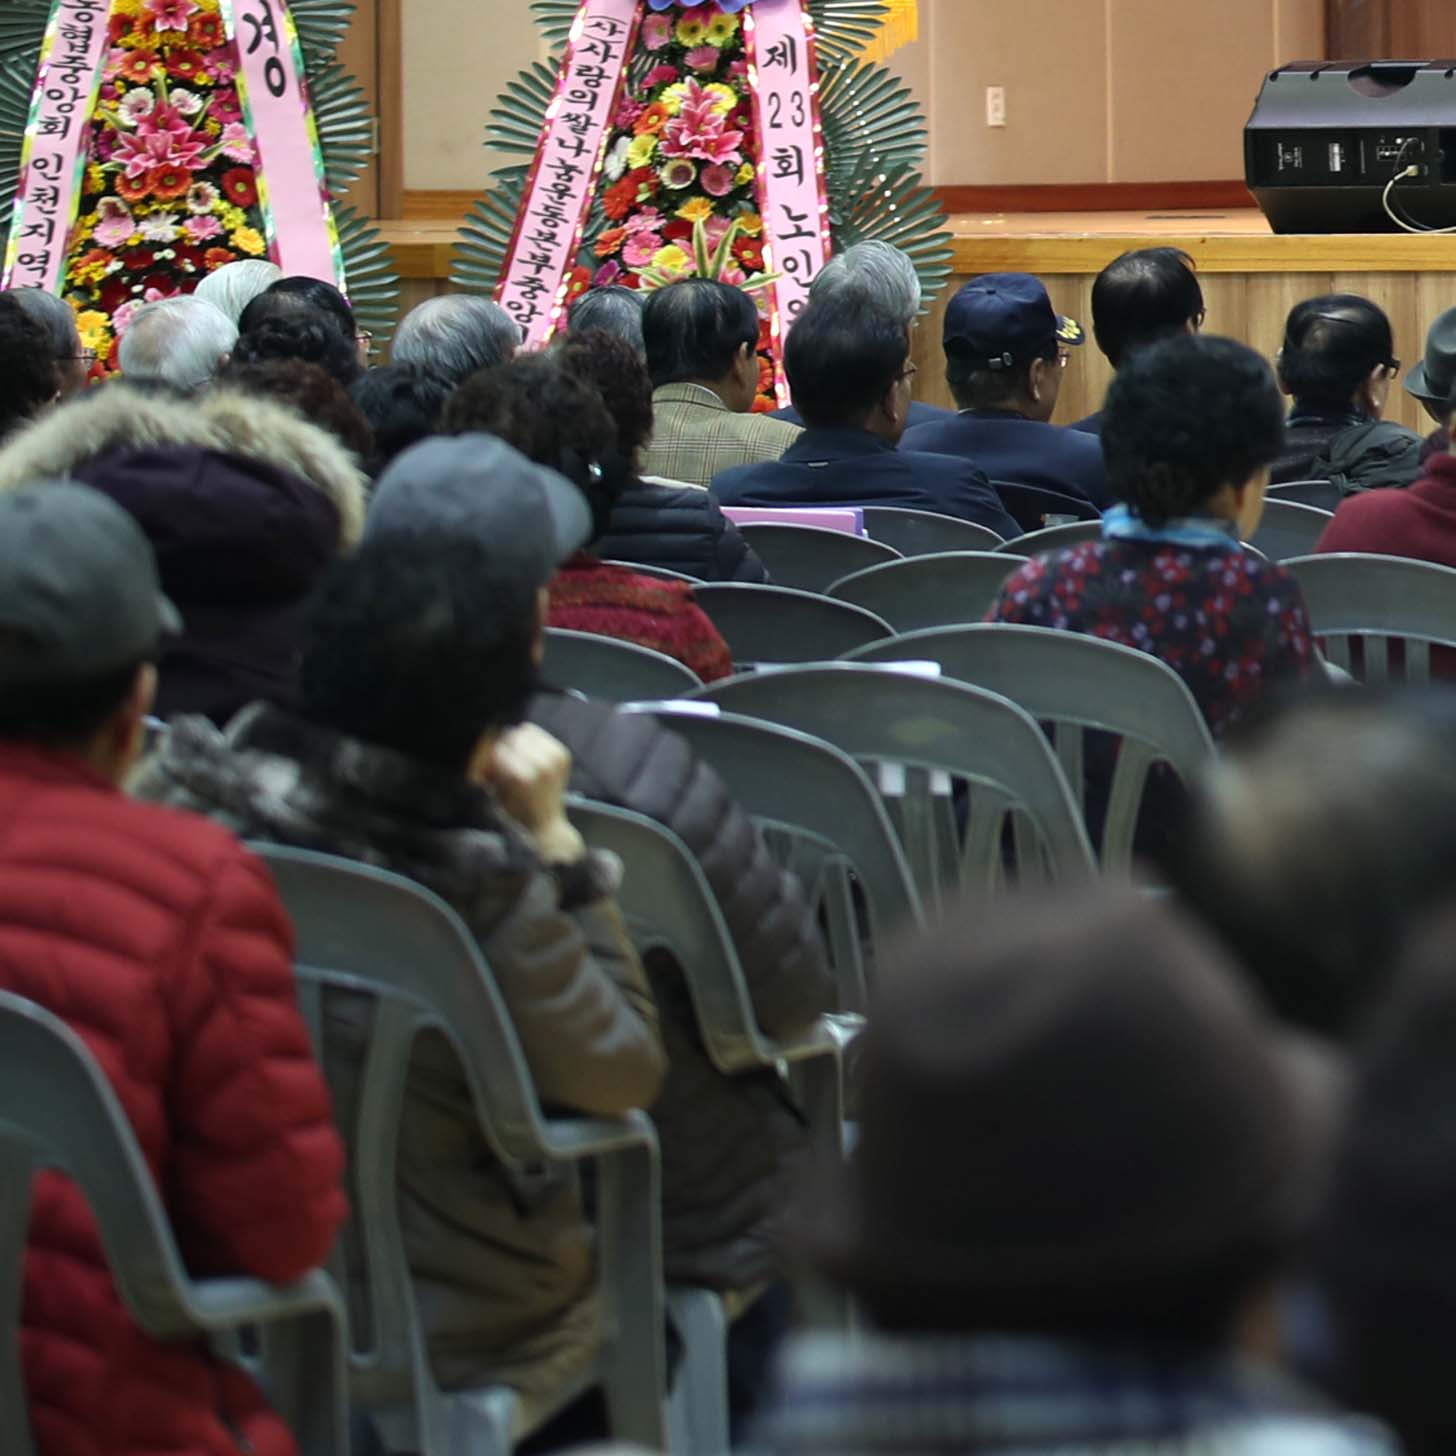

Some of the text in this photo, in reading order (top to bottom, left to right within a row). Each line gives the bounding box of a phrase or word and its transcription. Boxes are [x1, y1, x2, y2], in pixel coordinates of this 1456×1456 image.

[761, 33, 799, 76] 제
[766, 90, 806, 130] 23
[505, 14, 628, 344] (사)사랑의쌀나눔운동본부중앙
[769, 144, 805, 187] 회
[17, 152, 63, 290] 인천지역
